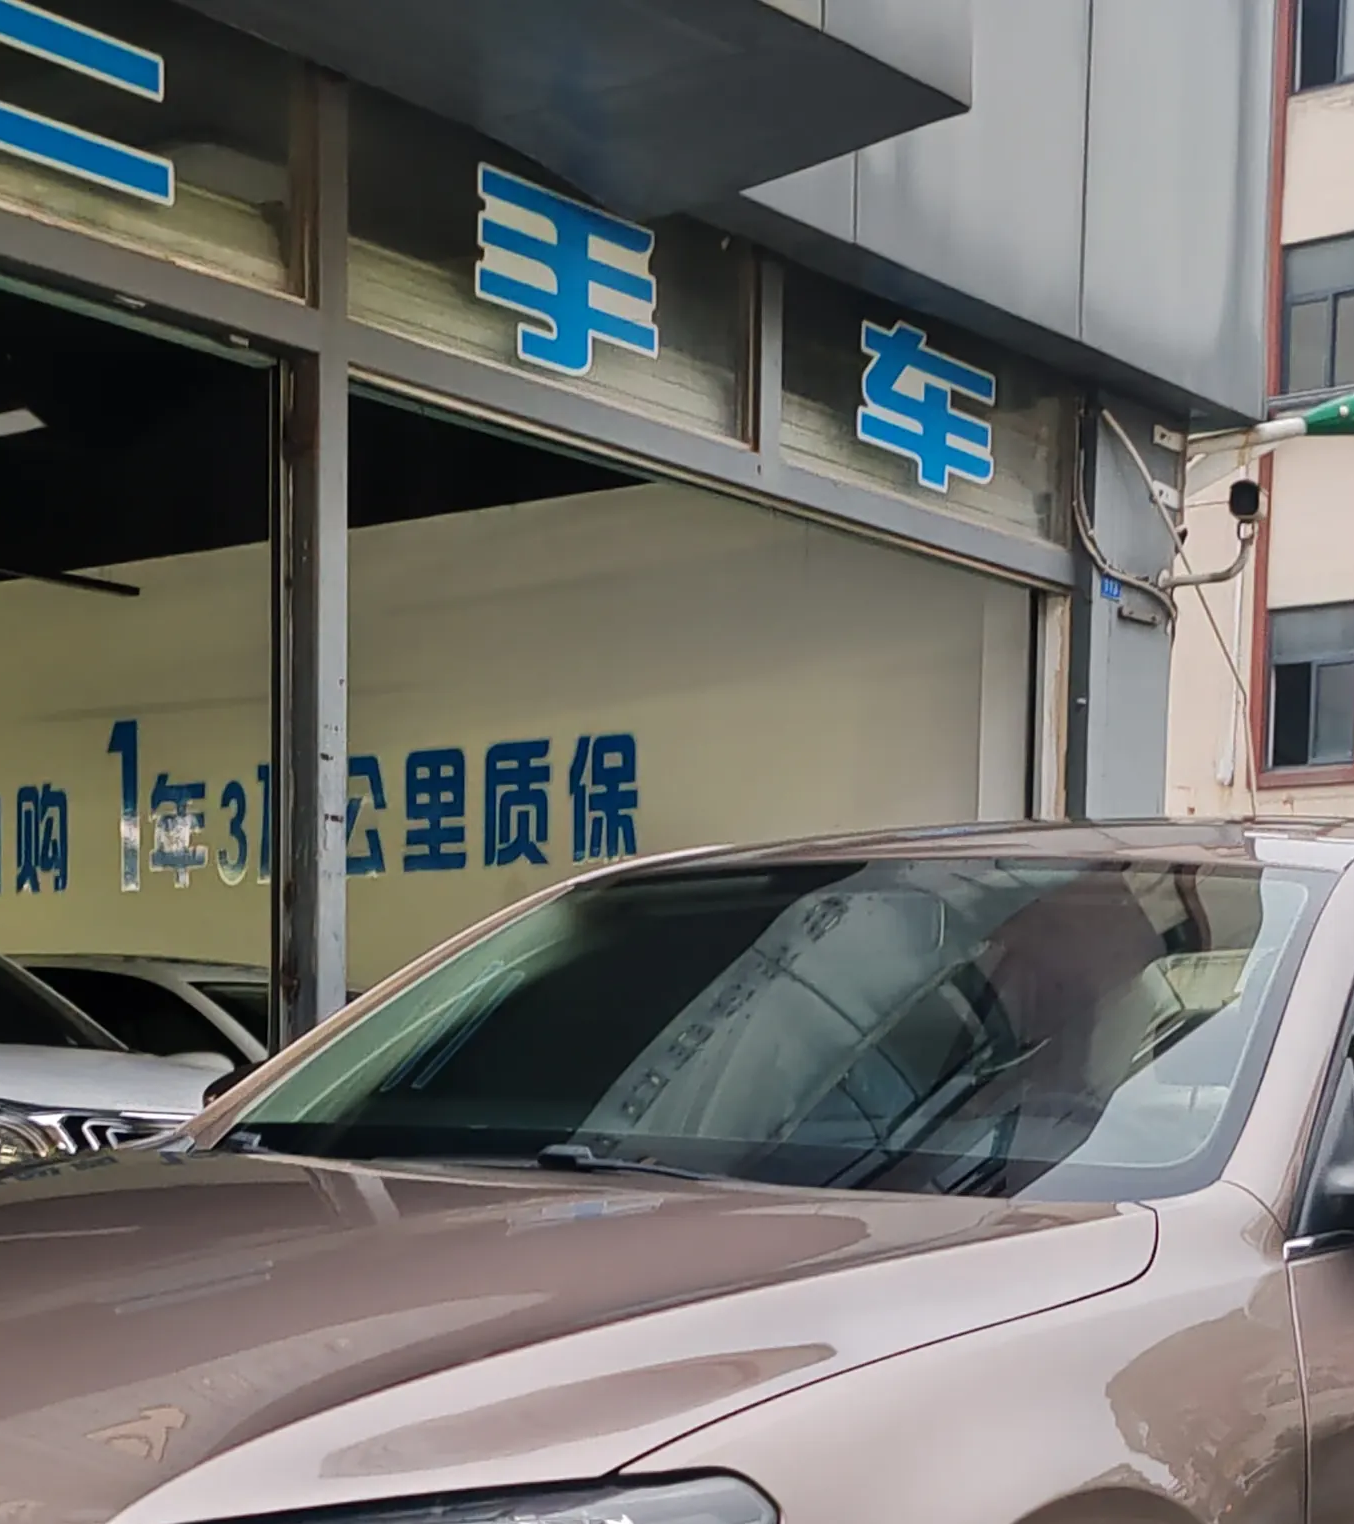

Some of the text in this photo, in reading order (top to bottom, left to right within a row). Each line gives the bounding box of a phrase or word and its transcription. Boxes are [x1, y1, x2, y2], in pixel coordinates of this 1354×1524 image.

[106, 719, 639, 893] 1年3公里质保
